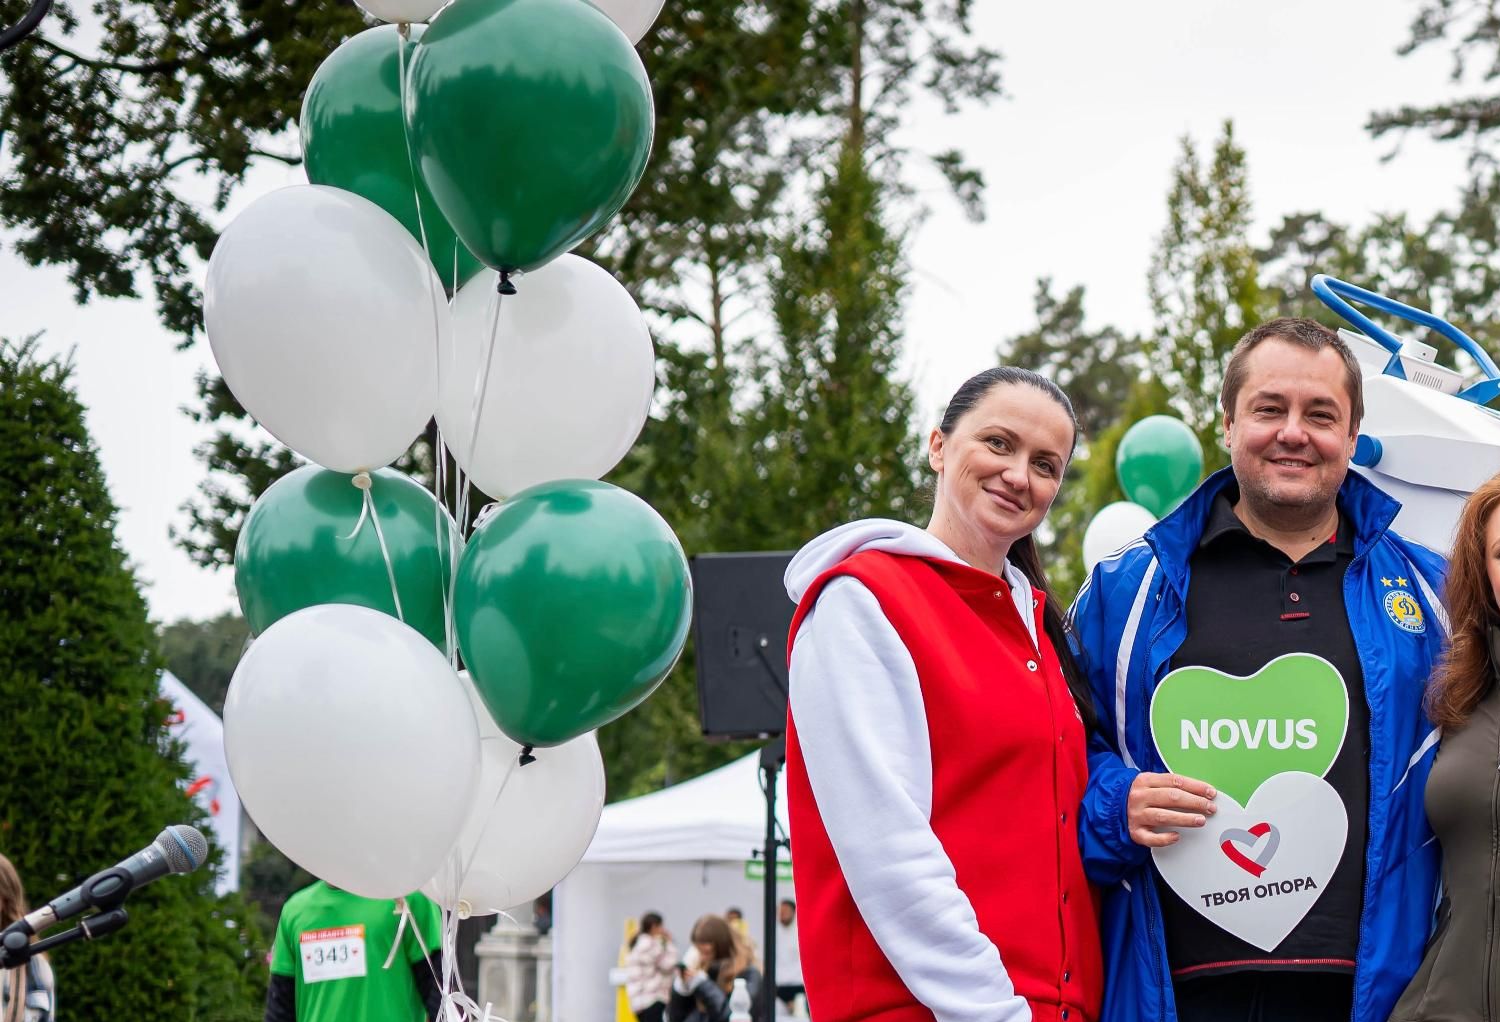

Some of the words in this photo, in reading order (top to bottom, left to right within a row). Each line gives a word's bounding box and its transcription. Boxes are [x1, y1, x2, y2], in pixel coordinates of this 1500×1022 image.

[1180, 718, 1318, 751] NOVUS
[1200, 886, 1251, 908] ТВОЯ
[1254, 876, 1318, 900] ОПОРА
[314, 943, 349, 967] 343
